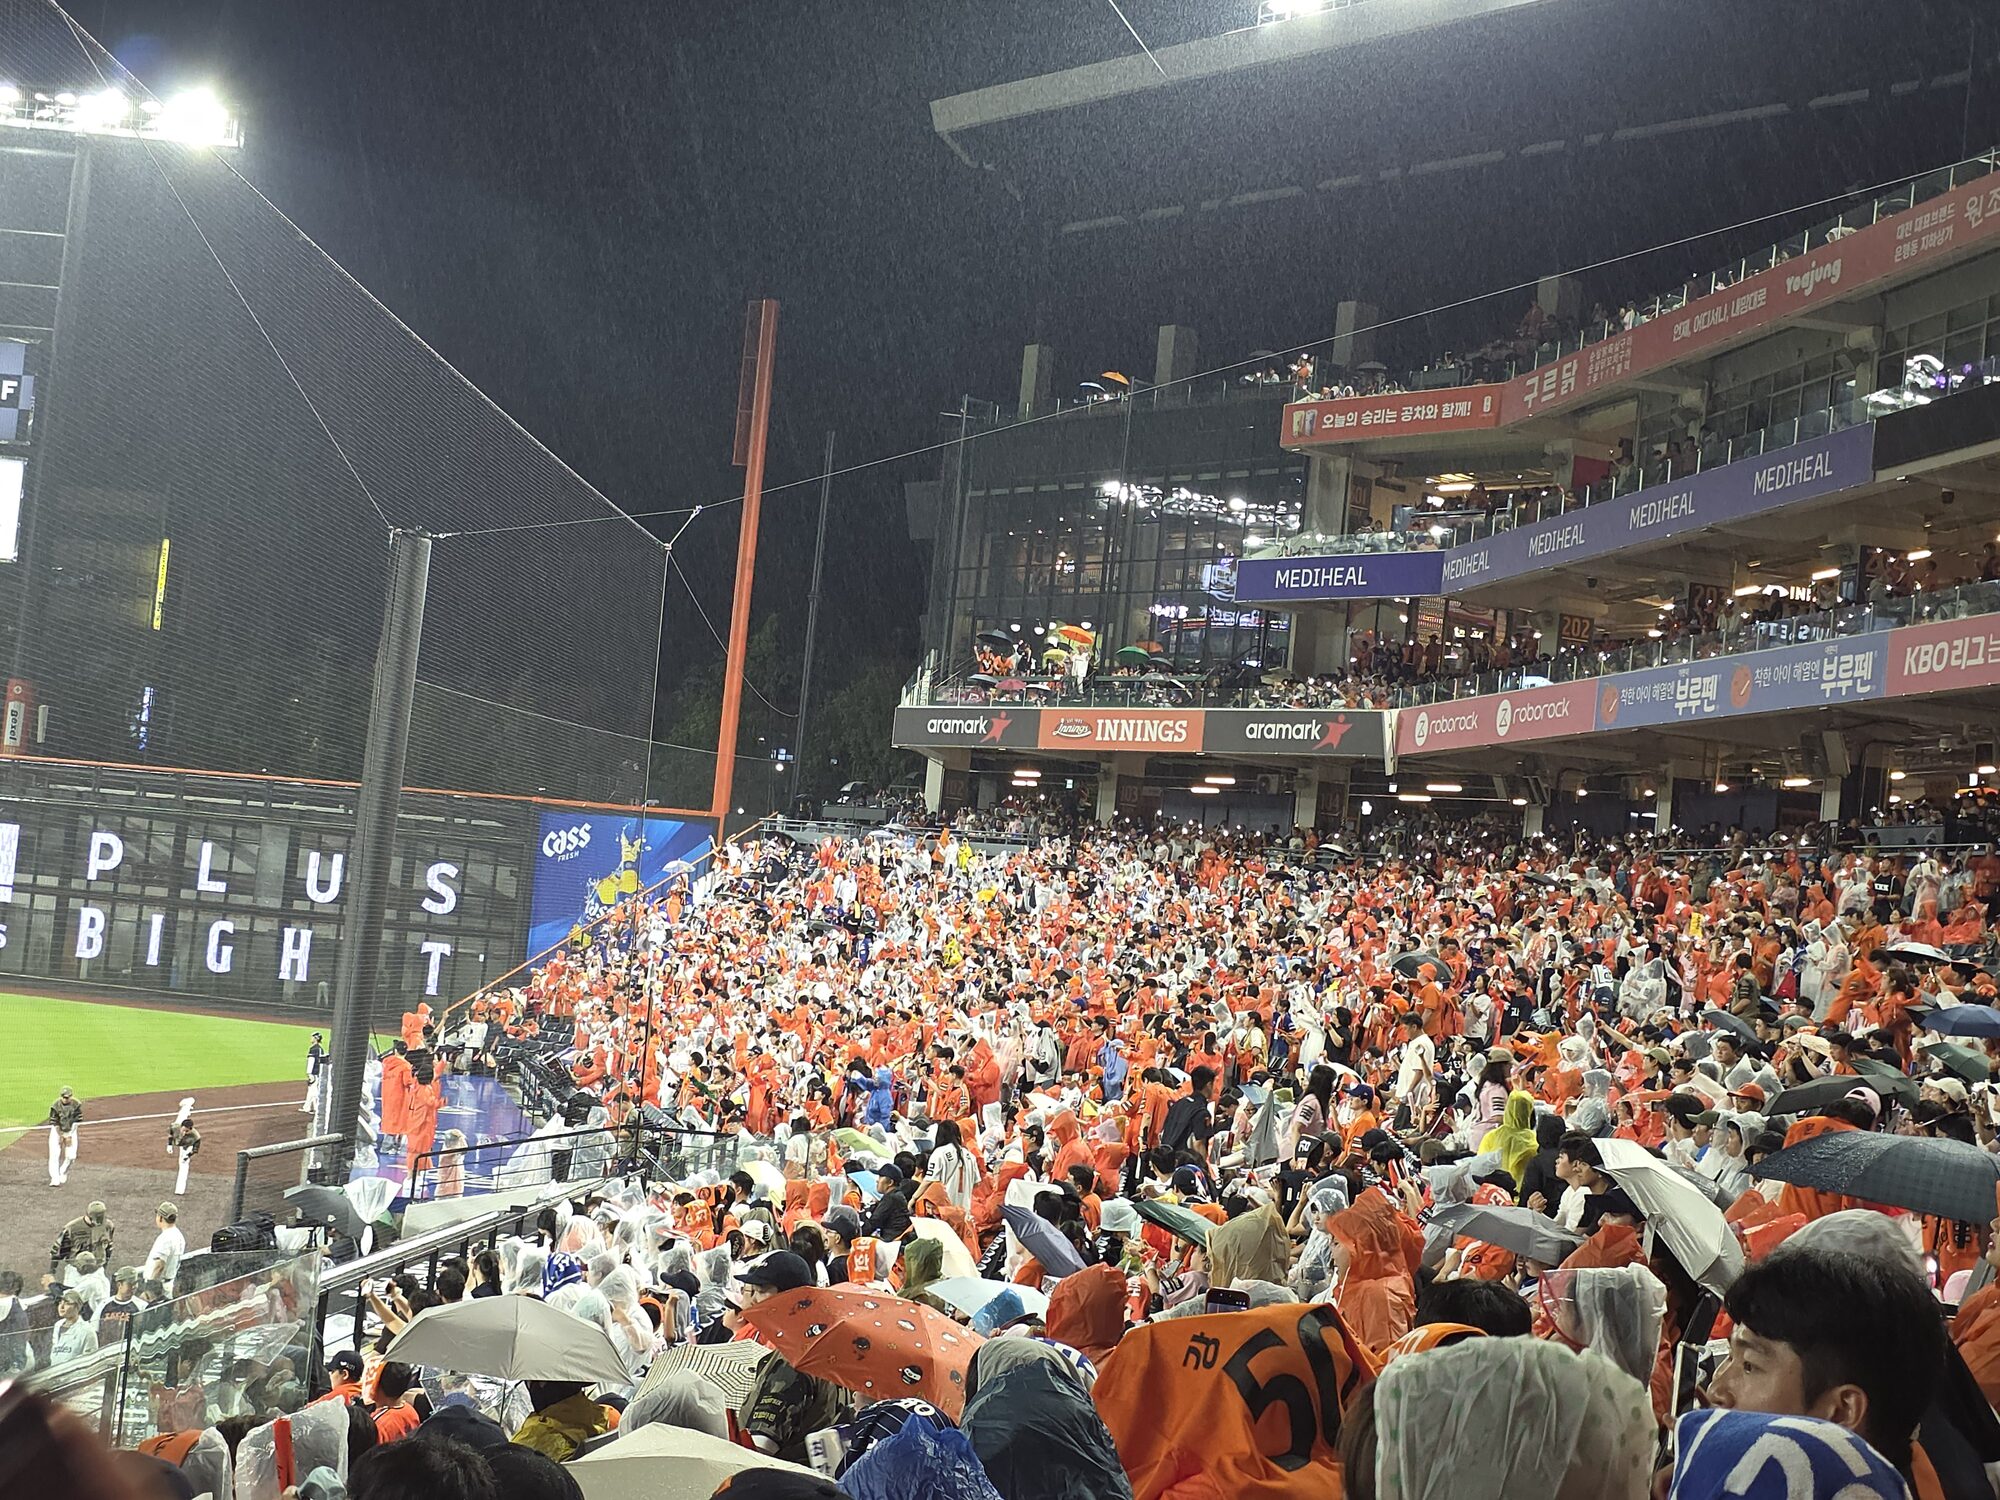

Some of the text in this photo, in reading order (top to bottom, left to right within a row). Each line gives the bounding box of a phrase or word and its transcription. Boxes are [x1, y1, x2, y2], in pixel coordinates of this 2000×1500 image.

[1321, 401, 1472, 430] 오늘의 승리는 공차와 함께!
[1753, 451, 1833, 496] MEDIHEAL
[1629, 491, 1695, 530] MEDIHEAL
[1528, 522, 1585, 557] MEDIHEAL
[1275, 566, 1367, 589] MEDIHEAL
[1442, 550, 1490, 583] MEDIHEAL
[1562, 616, 1591, 638] 202
[1754, 651, 1873, 698] 착한 아이 해열엔 부루펜
[1620, 674, 1718, 716] 착한 아이 해열엔 부루펜
[927, 715, 987, 735] aramark
[1429, 711, 1479, 736] roborock
[1512, 697, 1571, 725] roborock
[1095, 719, 1187, 742] INNINGS
[1246, 719, 1322, 740] aramark
[558, 851, 580, 863] FRESH
